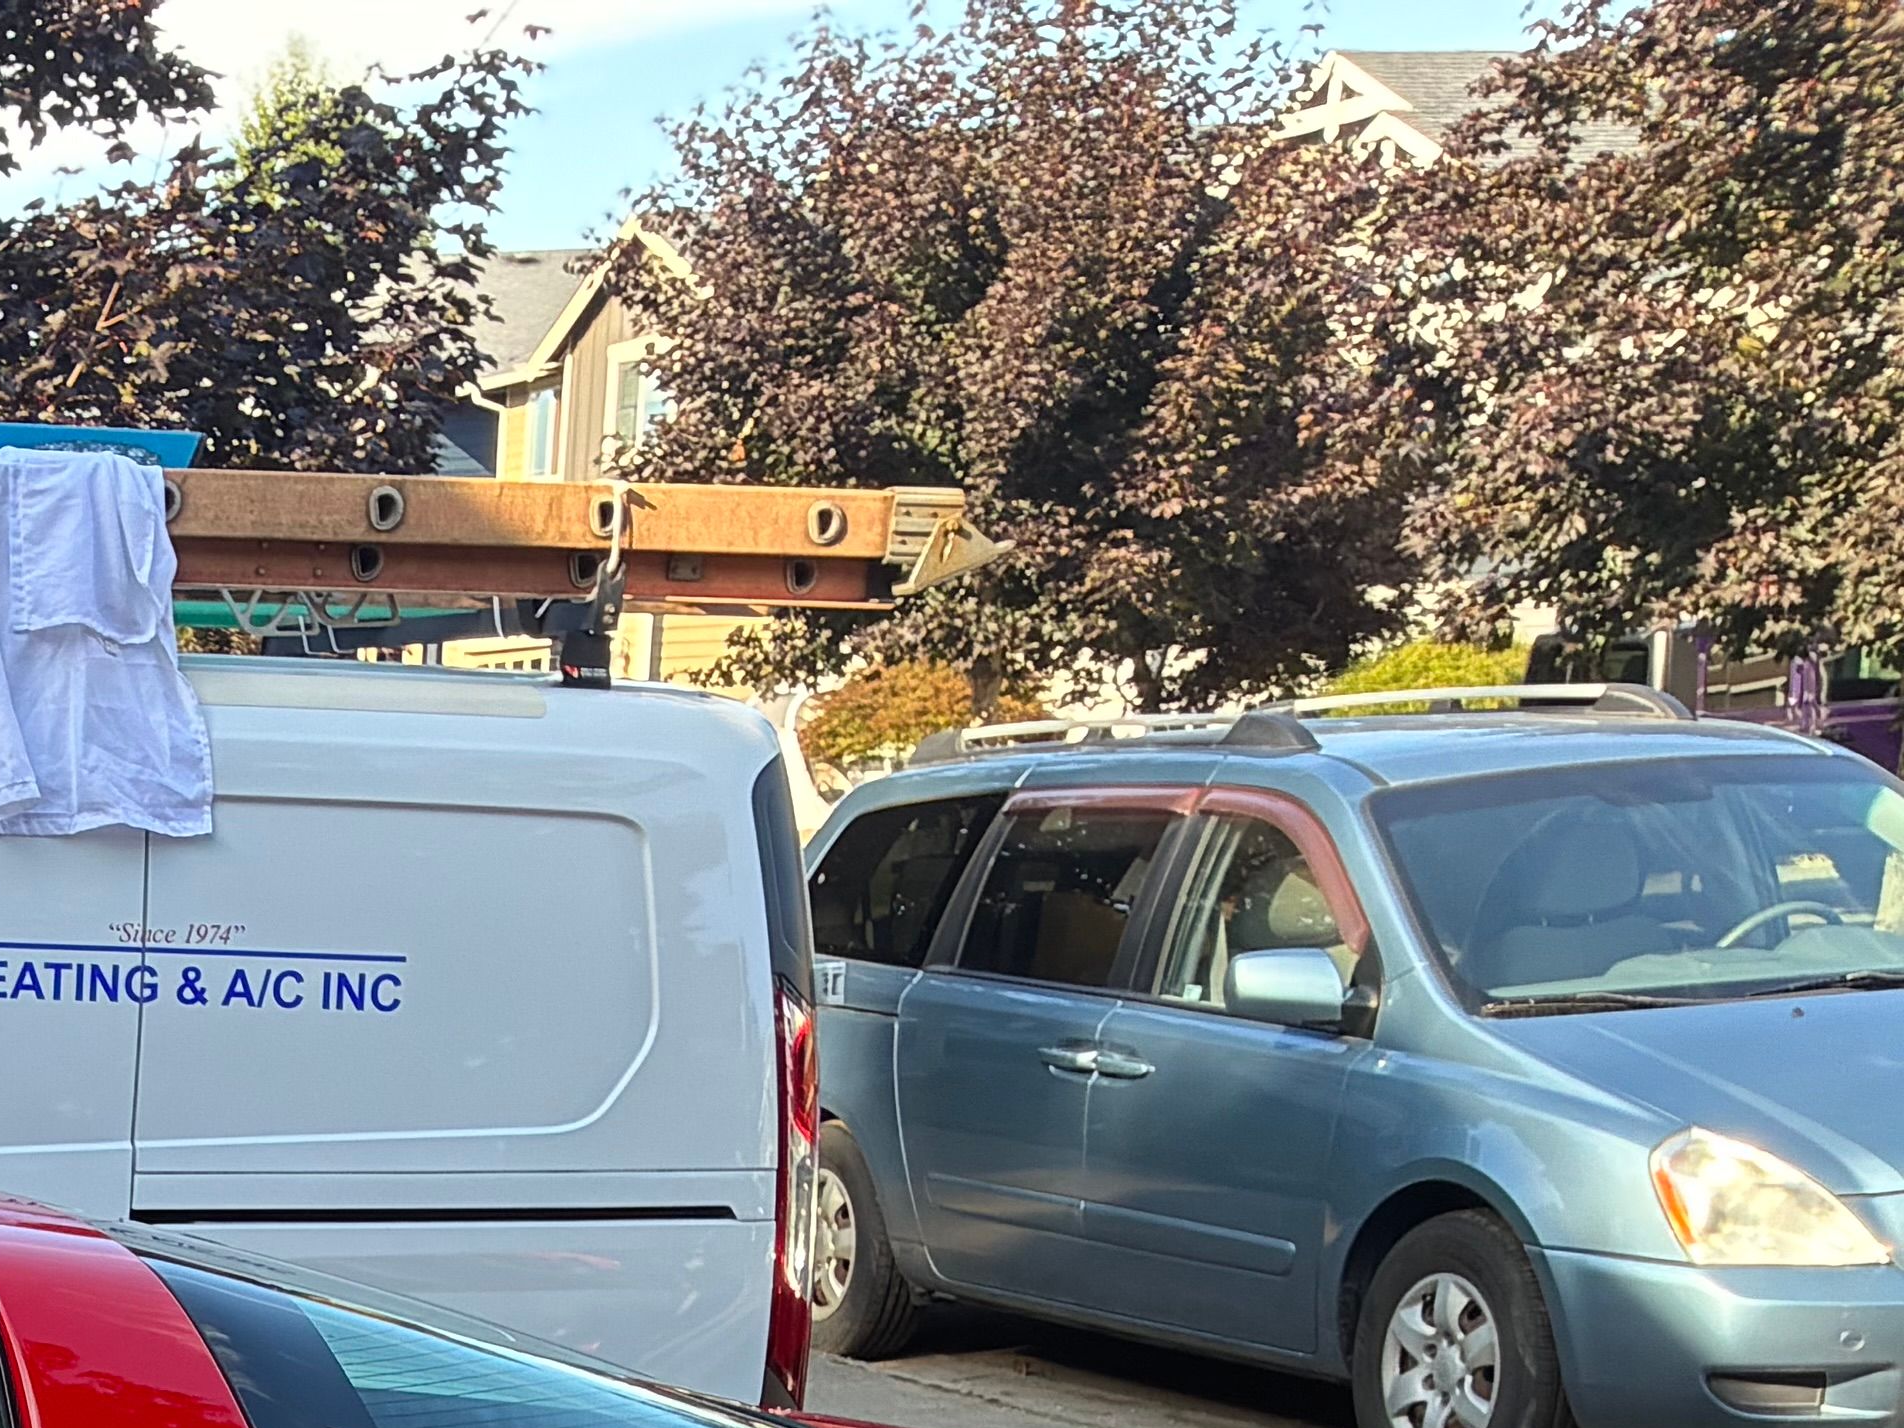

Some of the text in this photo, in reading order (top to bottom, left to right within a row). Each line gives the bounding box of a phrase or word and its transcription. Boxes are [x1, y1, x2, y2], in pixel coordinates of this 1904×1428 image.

[176, 966, 209, 1006] &
[221, 968, 304, 1009] A/C
[322, 971, 402, 1012] INC
